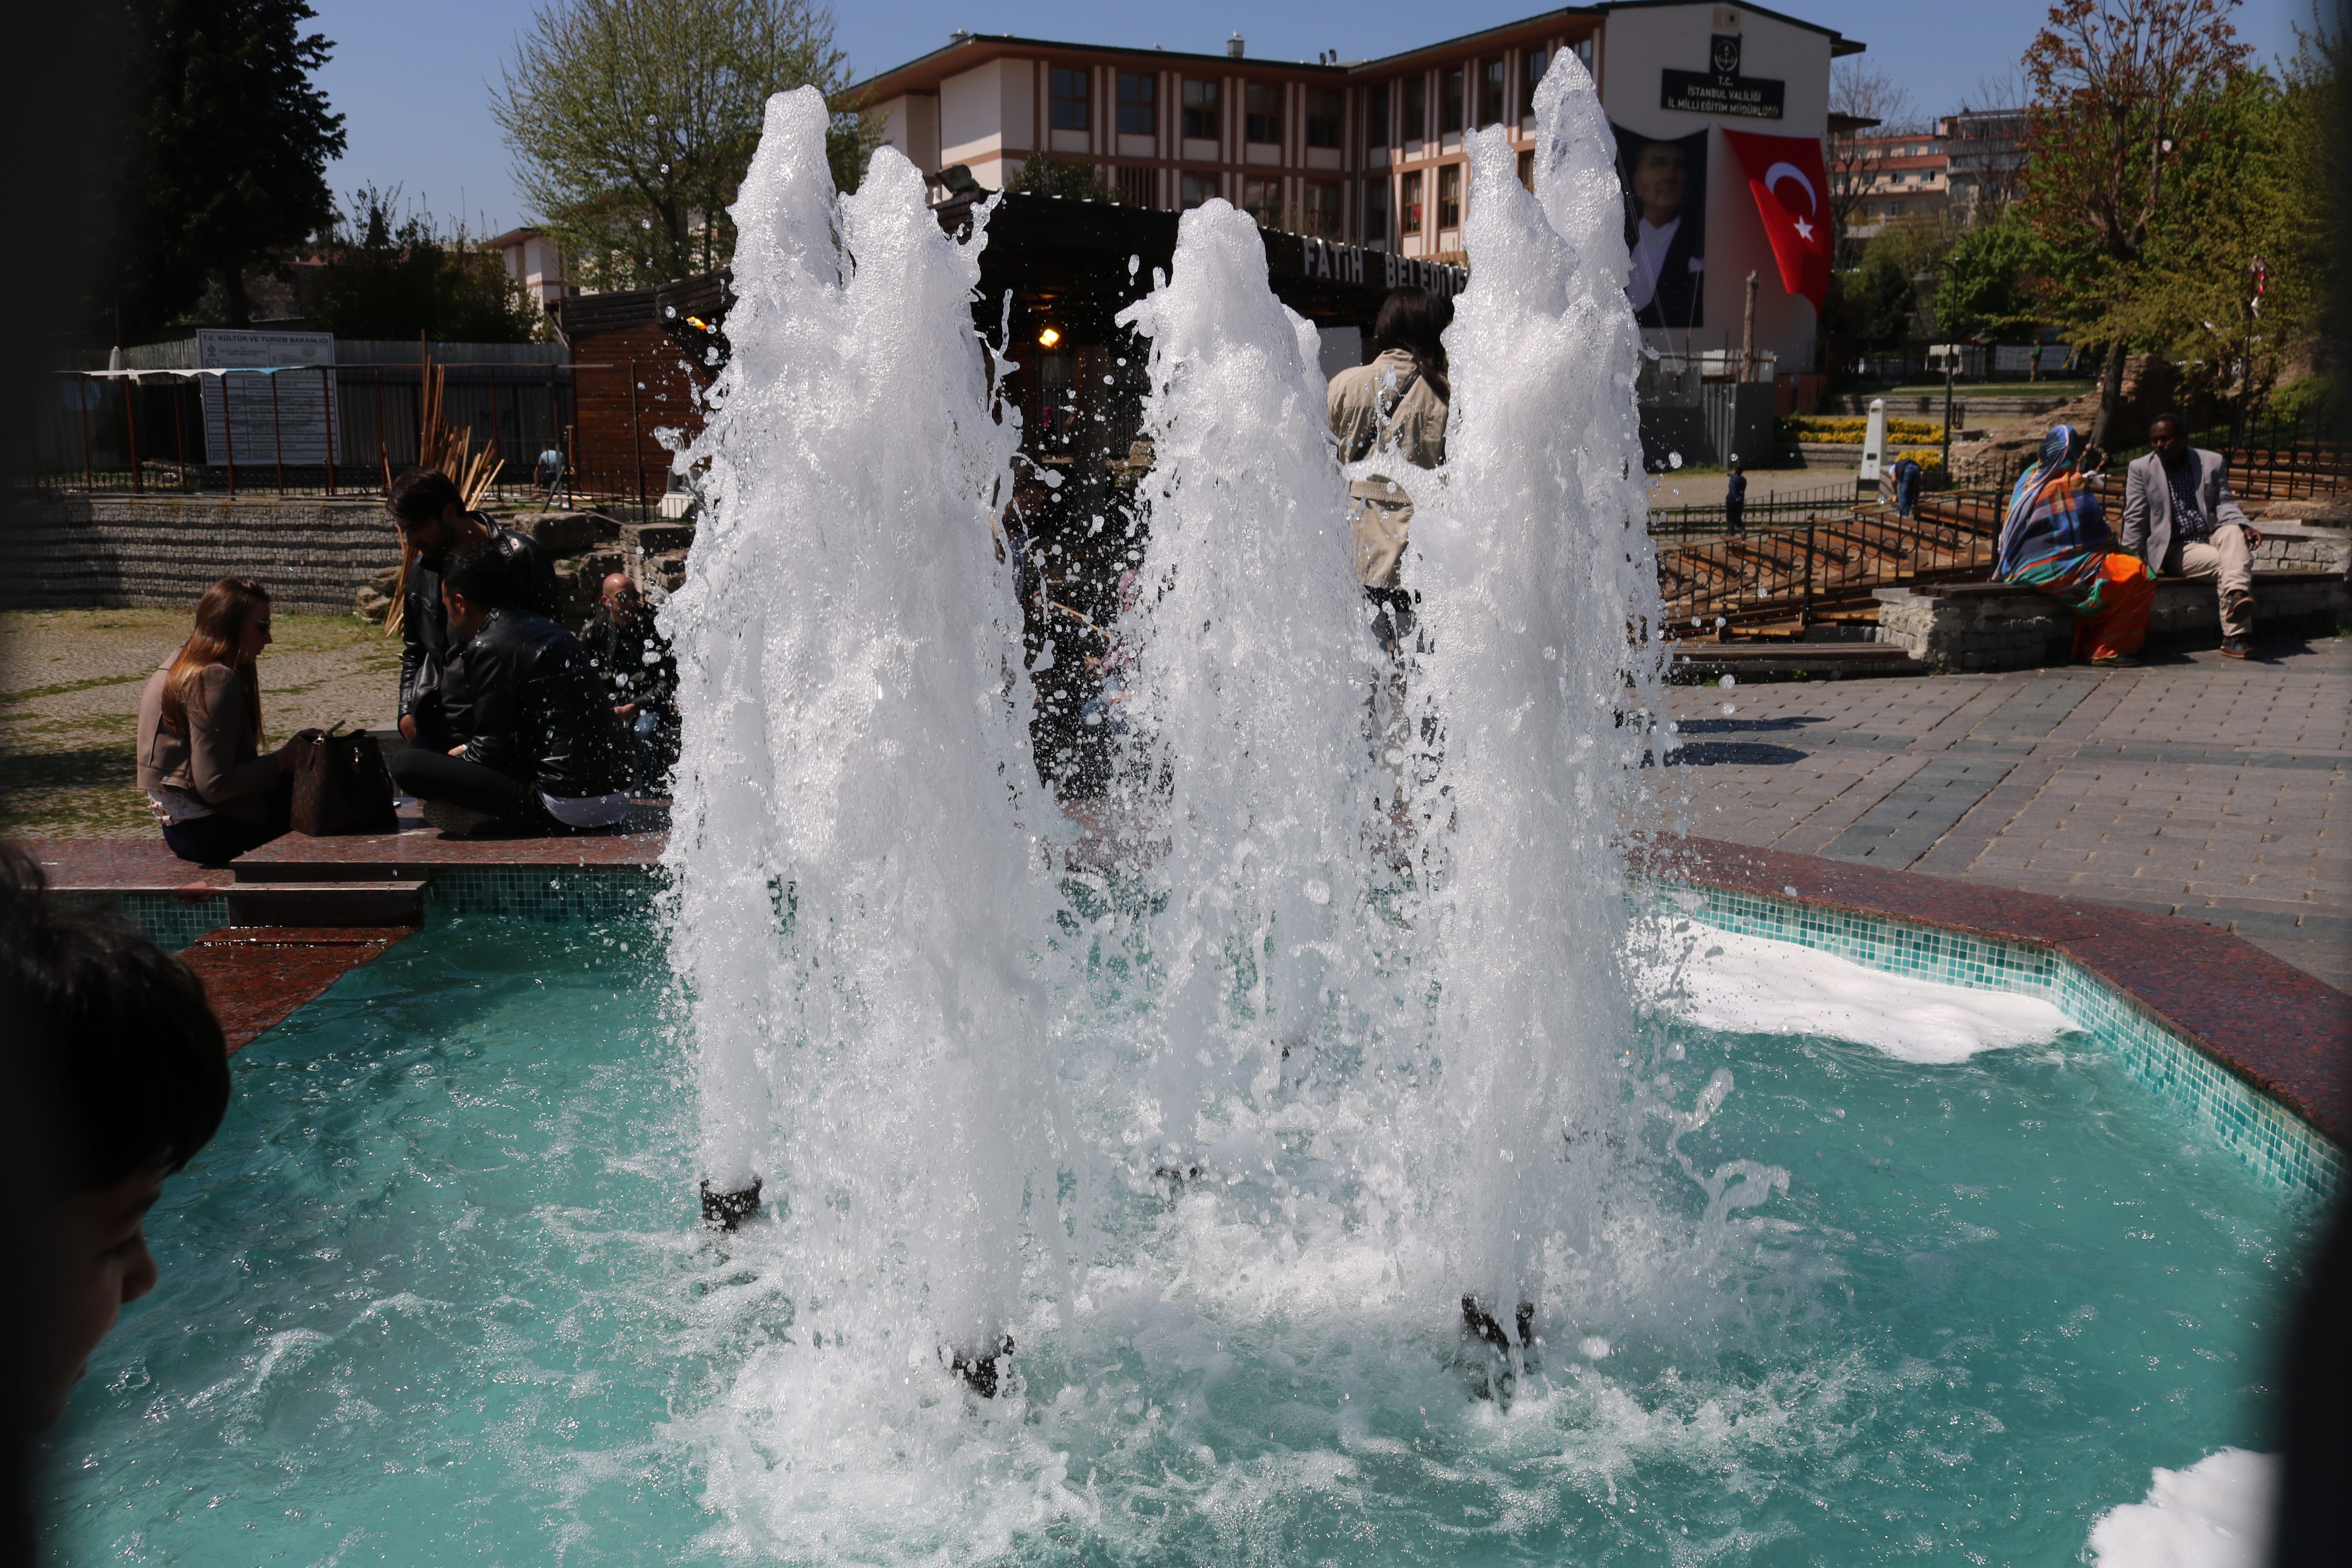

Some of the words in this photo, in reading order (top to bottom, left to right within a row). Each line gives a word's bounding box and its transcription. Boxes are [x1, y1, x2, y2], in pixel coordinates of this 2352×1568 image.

[1718, 75, 1733, 87] T.C.
[1687, 83, 1727, 100] İSTANBUL
[1728, 89, 1762, 103] VALİLİĞİ
[1668, 95, 1676, 108] İL
[1677, 97, 1699, 110] MİLLİ
[1701, 99, 1728, 113] EĞİTİM
[1385, 253, 1470, 297] BELEDİYE
